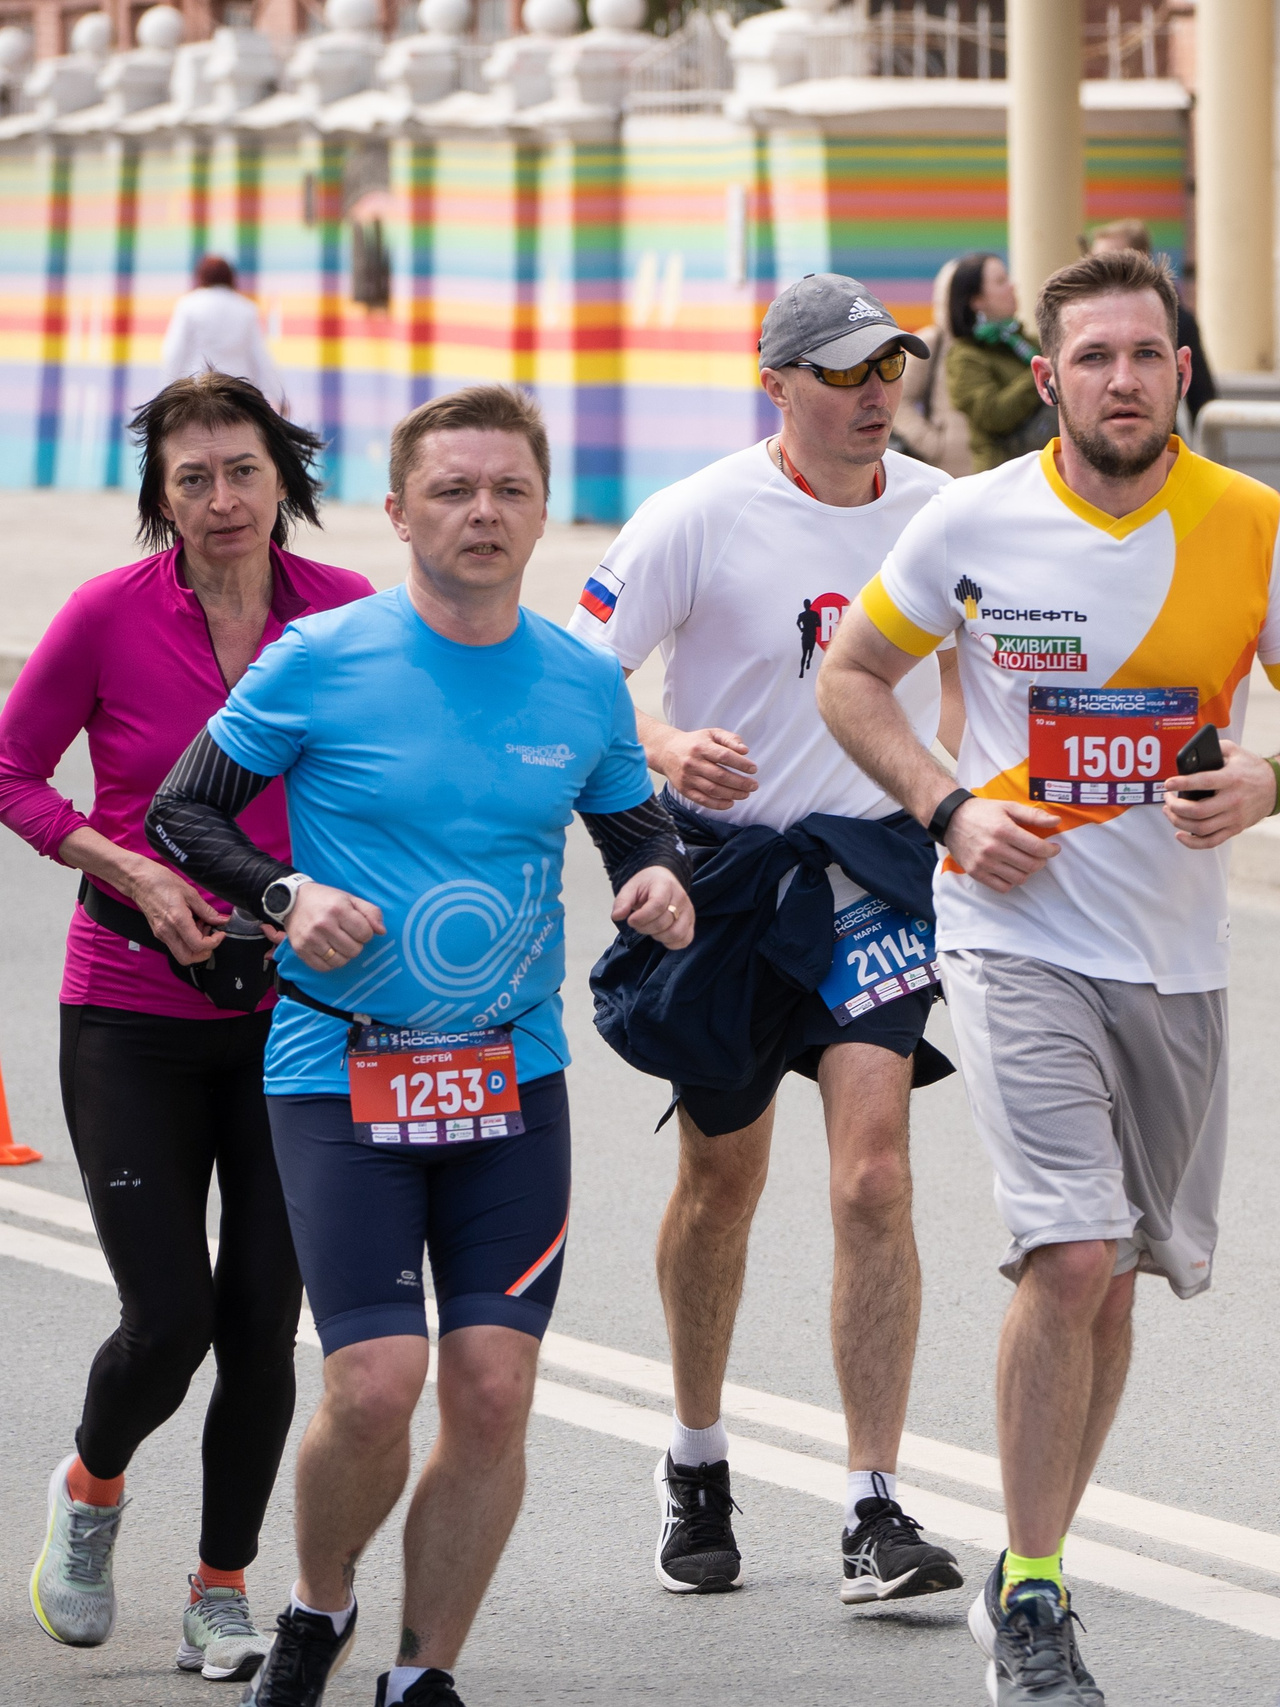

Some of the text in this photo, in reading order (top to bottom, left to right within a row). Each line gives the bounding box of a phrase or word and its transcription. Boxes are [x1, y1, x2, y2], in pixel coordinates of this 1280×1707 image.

[848, 309, 884, 322] adidas
[981, 608, 1088, 623] РОСНЕФТЬ
[999, 637, 1077, 655] ЖИВИТЕ
[998, 653, 1082, 670] ДОЛЬШЕ!
[1078, 694, 1146, 702] Я ПРОСТО
[1078, 701, 1146, 711] КОСМОС
[1035, 718, 1045, 726] 10
[521, 754, 566, 769] RUNNING
[1063, 735, 1161, 778] 1509
[835, 902, 891, 934] КОСМОС
[852, 921, 882, 941] МАРАТ
[914, 920, 928, 932] D
[846, 927, 927, 987] 2114
[472, 992, 511, 1028] ЭТО
[400, 1032, 469, 1047] КОСМОС
[355, 1061, 365, 1069] 10
[412, 1052, 453, 1064] СЕРГЕЙ
[490, 1075, 503, 1090] D
[389, 1067, 485, 1118] 1253
